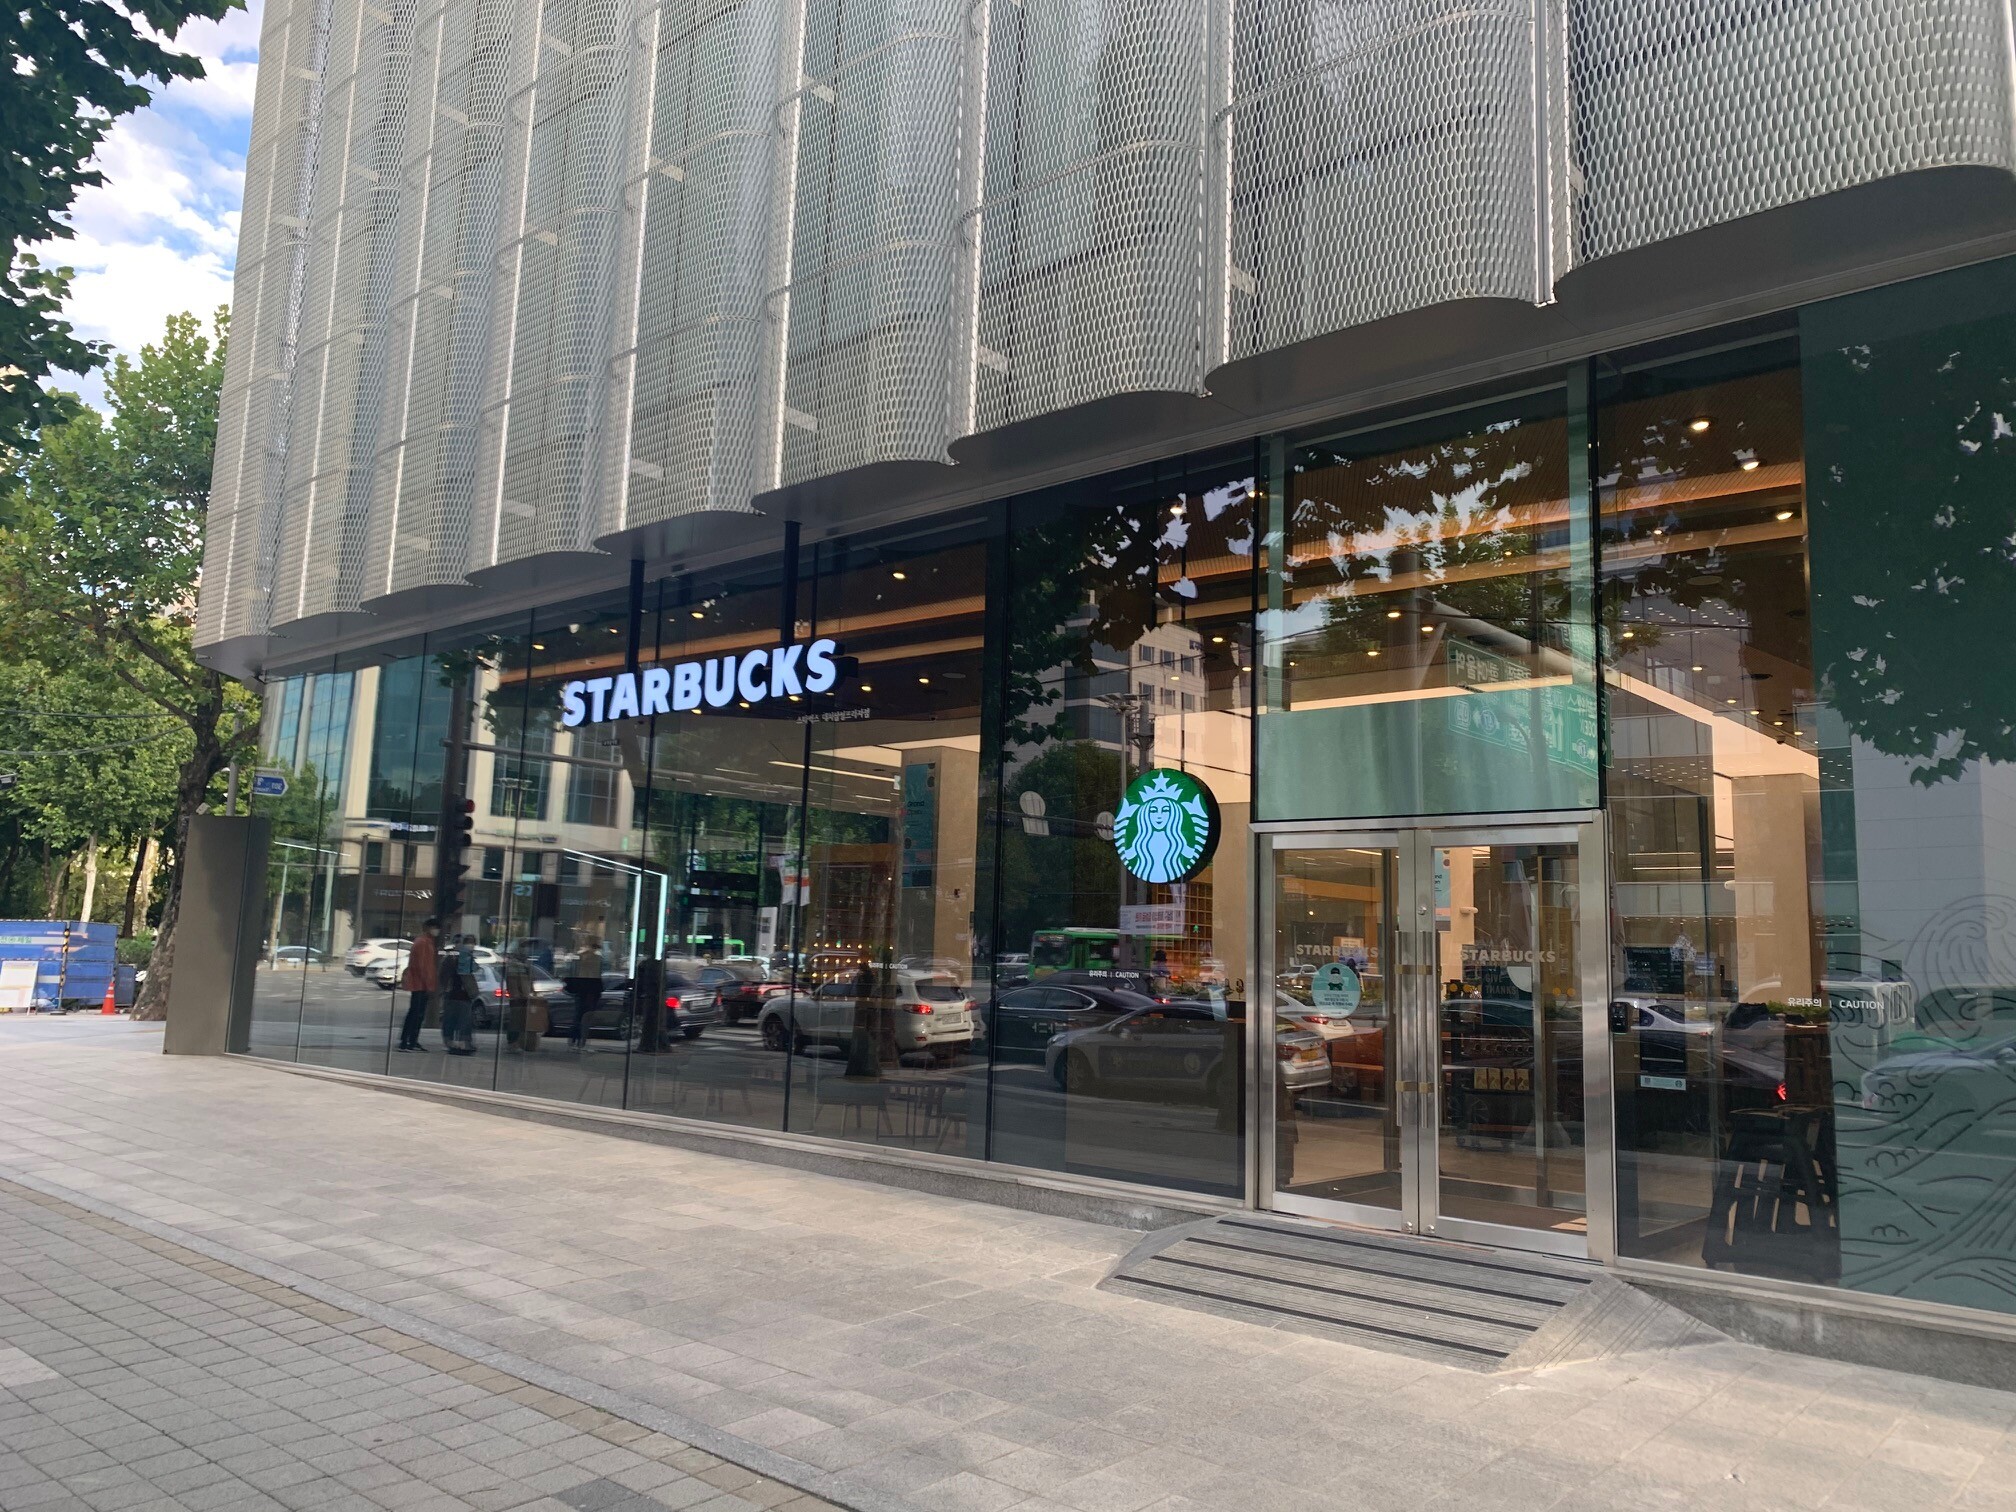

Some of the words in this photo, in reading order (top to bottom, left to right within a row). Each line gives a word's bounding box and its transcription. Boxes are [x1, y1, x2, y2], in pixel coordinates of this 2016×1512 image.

[562, 638, 838, 727] STARBUCKS
[1296, 944, 1379, 958] STARBKS
[1461, 949, 1556, 963] STARBUCKS
[1115, 970, 1140, 979] CAUTION
[1486, 985, 1517, 995] THANKS
[1787, 997, 1822, 1008] 유리주의
[1839, 999, 1885, 1010] CAUTION
